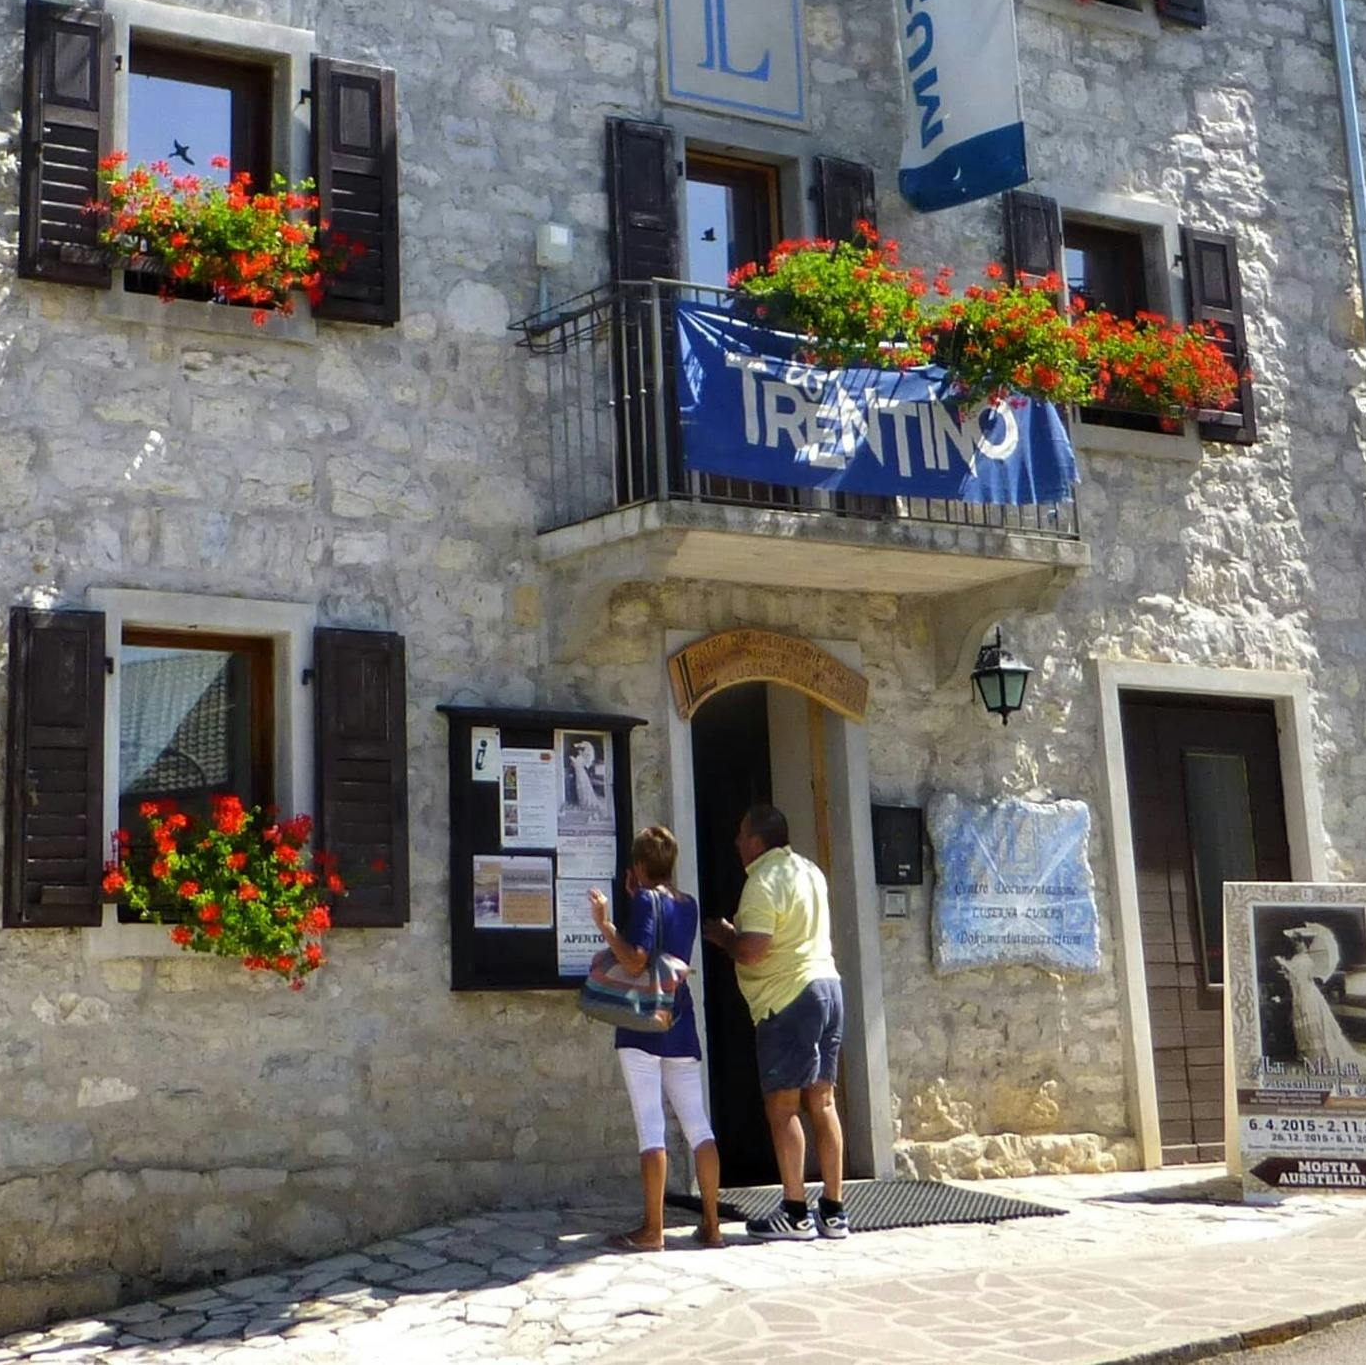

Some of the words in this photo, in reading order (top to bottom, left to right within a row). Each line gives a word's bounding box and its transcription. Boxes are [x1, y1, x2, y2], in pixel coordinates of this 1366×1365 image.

[724, 351, 1020, 478] TRENTINO
[563, 933, 605, 945] APERTO
[1281, 1119, 1315, 1132] 2015
[1298, 1160, 1360, 1173] MOSTRA
